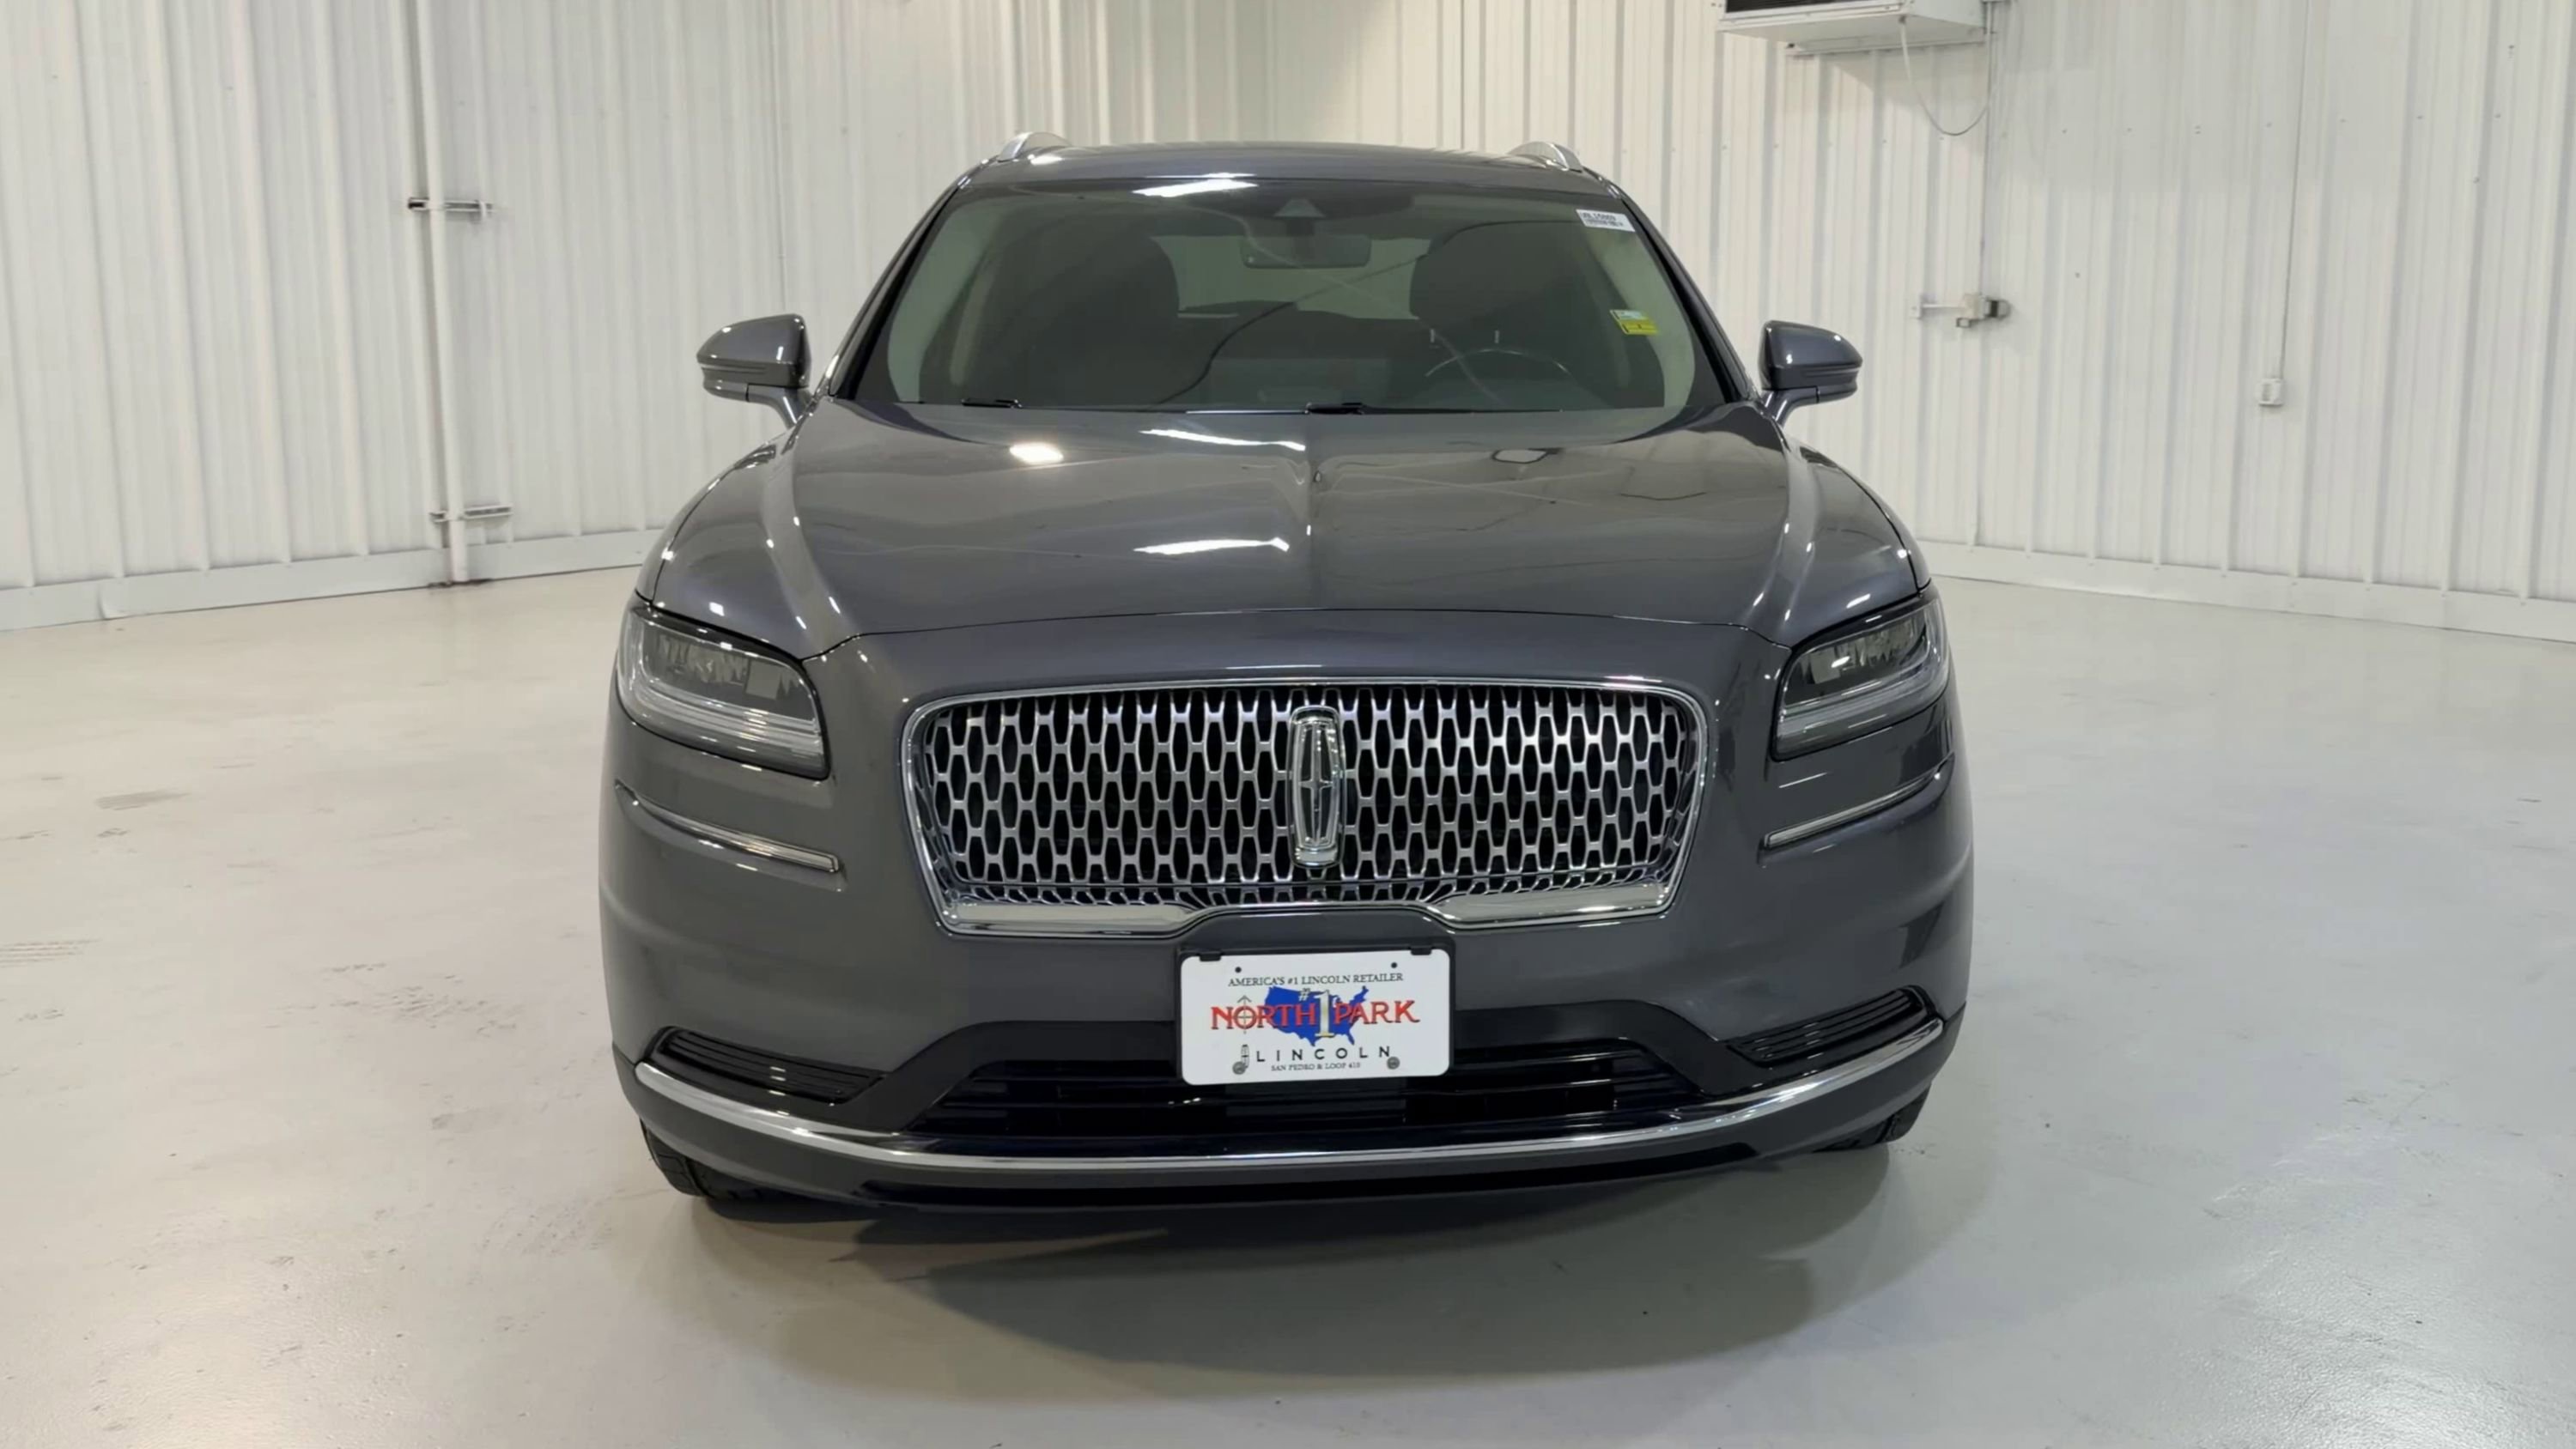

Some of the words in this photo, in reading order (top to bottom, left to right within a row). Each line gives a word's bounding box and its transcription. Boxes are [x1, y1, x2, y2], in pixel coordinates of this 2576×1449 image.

[1228, 977, 1285, 986] AMERICA'S
[1288, 977, 1298, 985] #1
[1301, 975, 1352, 985] LINCOLN
[1352, 973, 1404, 983] RETAILER
[1211, 1003, 1317, 1030] NORTH
[1333, 1000, 1421, 1026] PARK
[1255, 1046, 1391, 1063] LINCOLN
